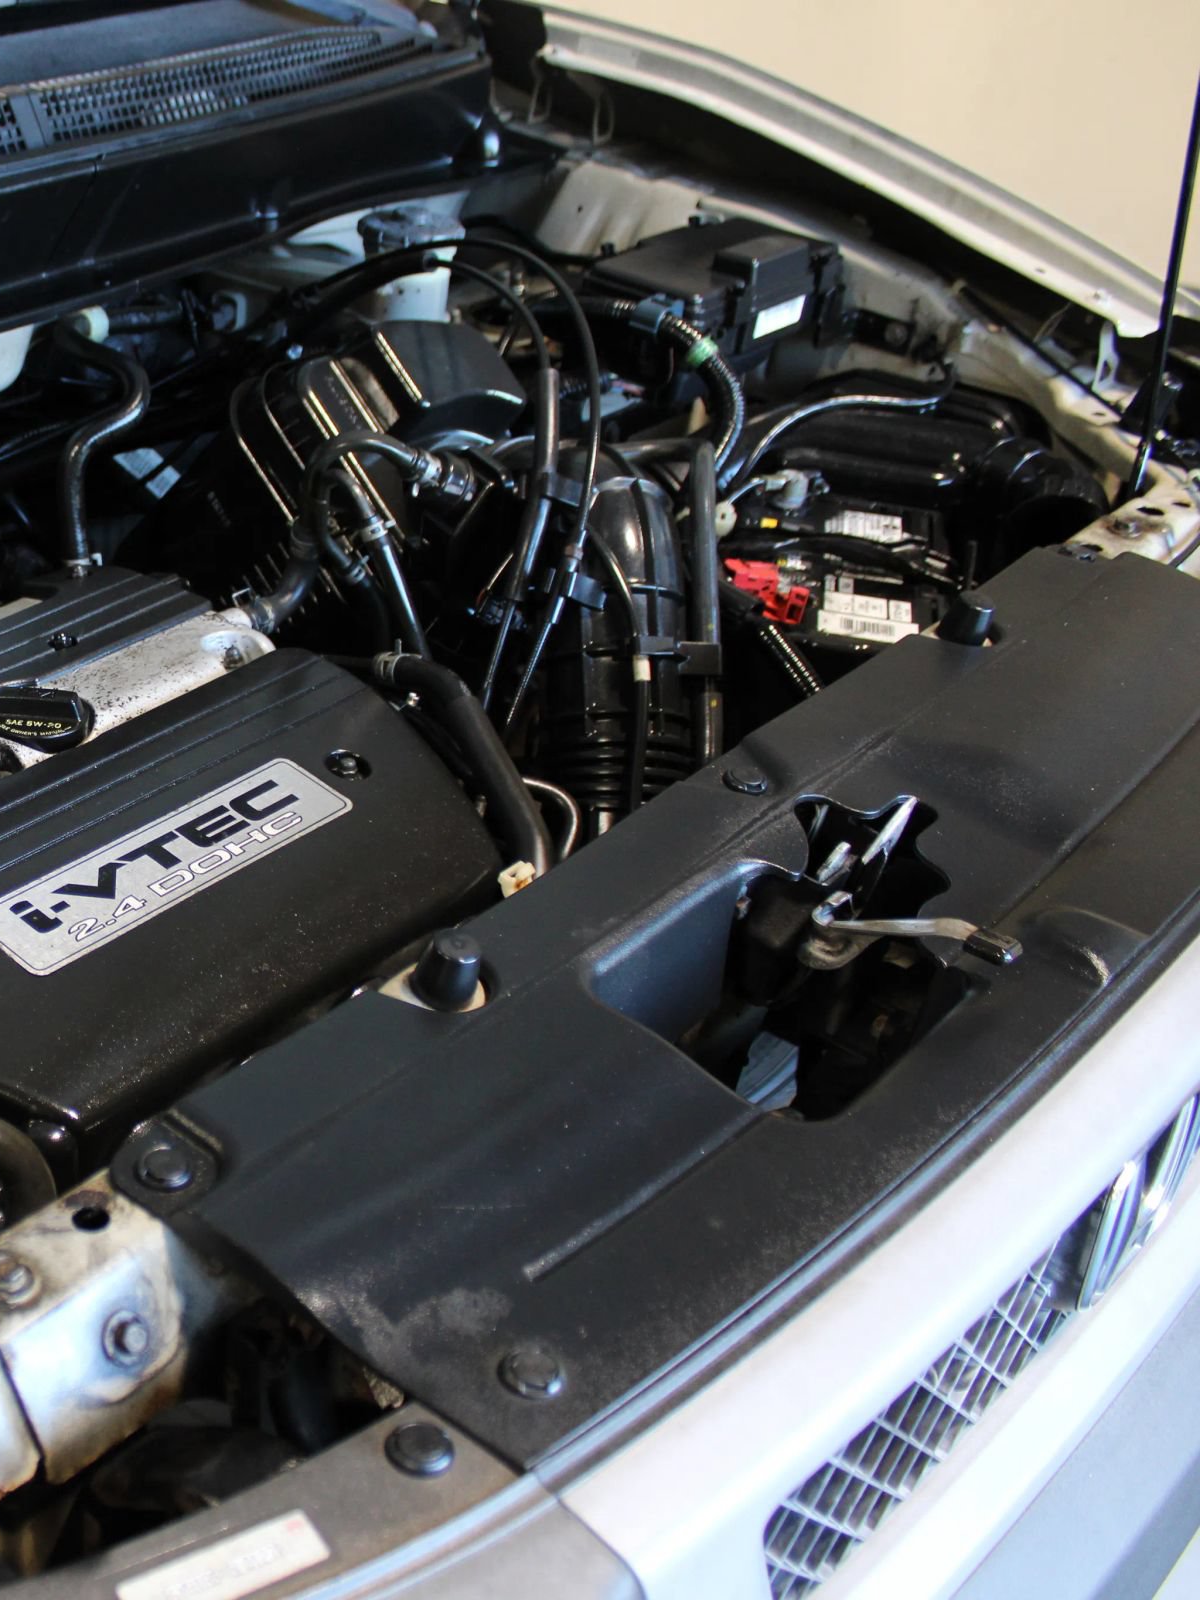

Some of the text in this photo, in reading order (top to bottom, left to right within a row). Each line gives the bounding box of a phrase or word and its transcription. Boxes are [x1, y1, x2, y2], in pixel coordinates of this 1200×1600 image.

[9, 779, 299, 934] i-VTEC
[67, 811, 303, 942] 2.4 DOHC
